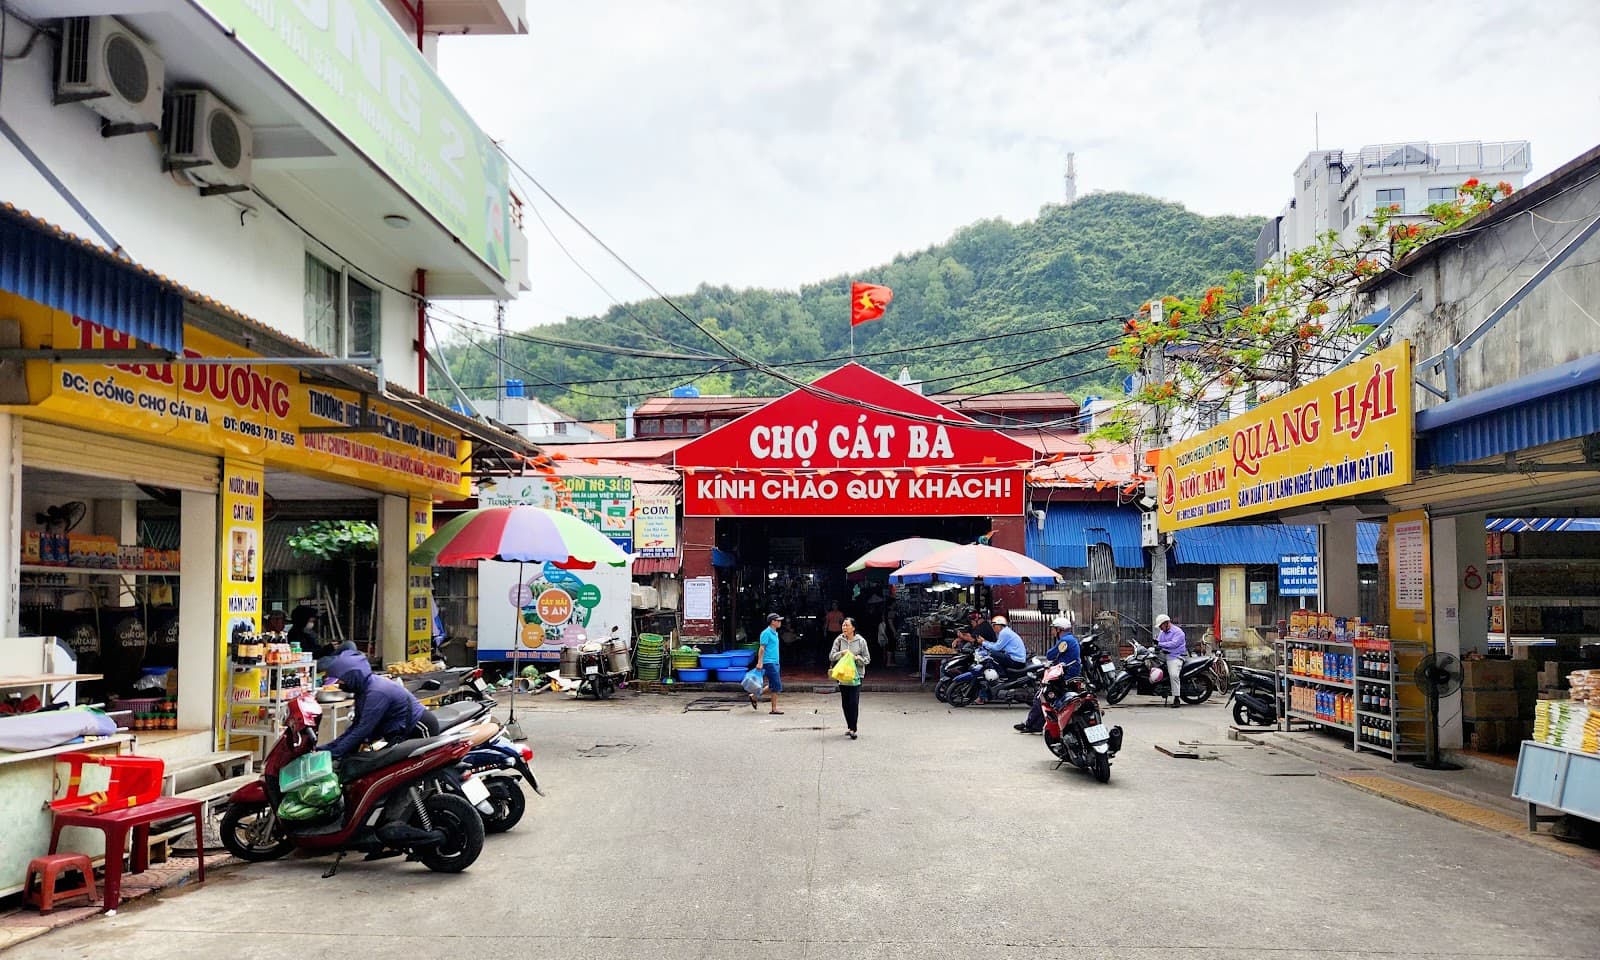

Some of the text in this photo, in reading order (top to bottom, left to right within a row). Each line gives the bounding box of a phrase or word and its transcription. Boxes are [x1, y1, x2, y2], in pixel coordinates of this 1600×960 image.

[62, 371, 295, 446] ĐC: CỔNG CHỢ CÁT BÀ ĐT: 0983 781 555
[1232, 362, 1398, 477] QUANG HẢI
[749, 414, 955, 468] CHỢ CÁT BÀ
[697, 474, 755, 499] KÍNH
[762, 474, 839, 499] CHÀO
[908, 474, 1011, 499] KHÁCH!
[1179, 460, 1227, 501] NƯỚC MẮM
[1238, 484, 1250, 507] SẢN
[1250, 480, 1265, 505] XUẤT
[1266, 482, 1276, 504] TẠI
[1276, 475, 1293, 499] LÀNG
[1314, 462, 1334, 491] NƯỚC
[1336, 456, 1357, 486] MẮM
[1359, 452, 1375, 480] CÁT
[1377, 444, 1393, 477] HẢI
[552, 606, 568, 615] AN
